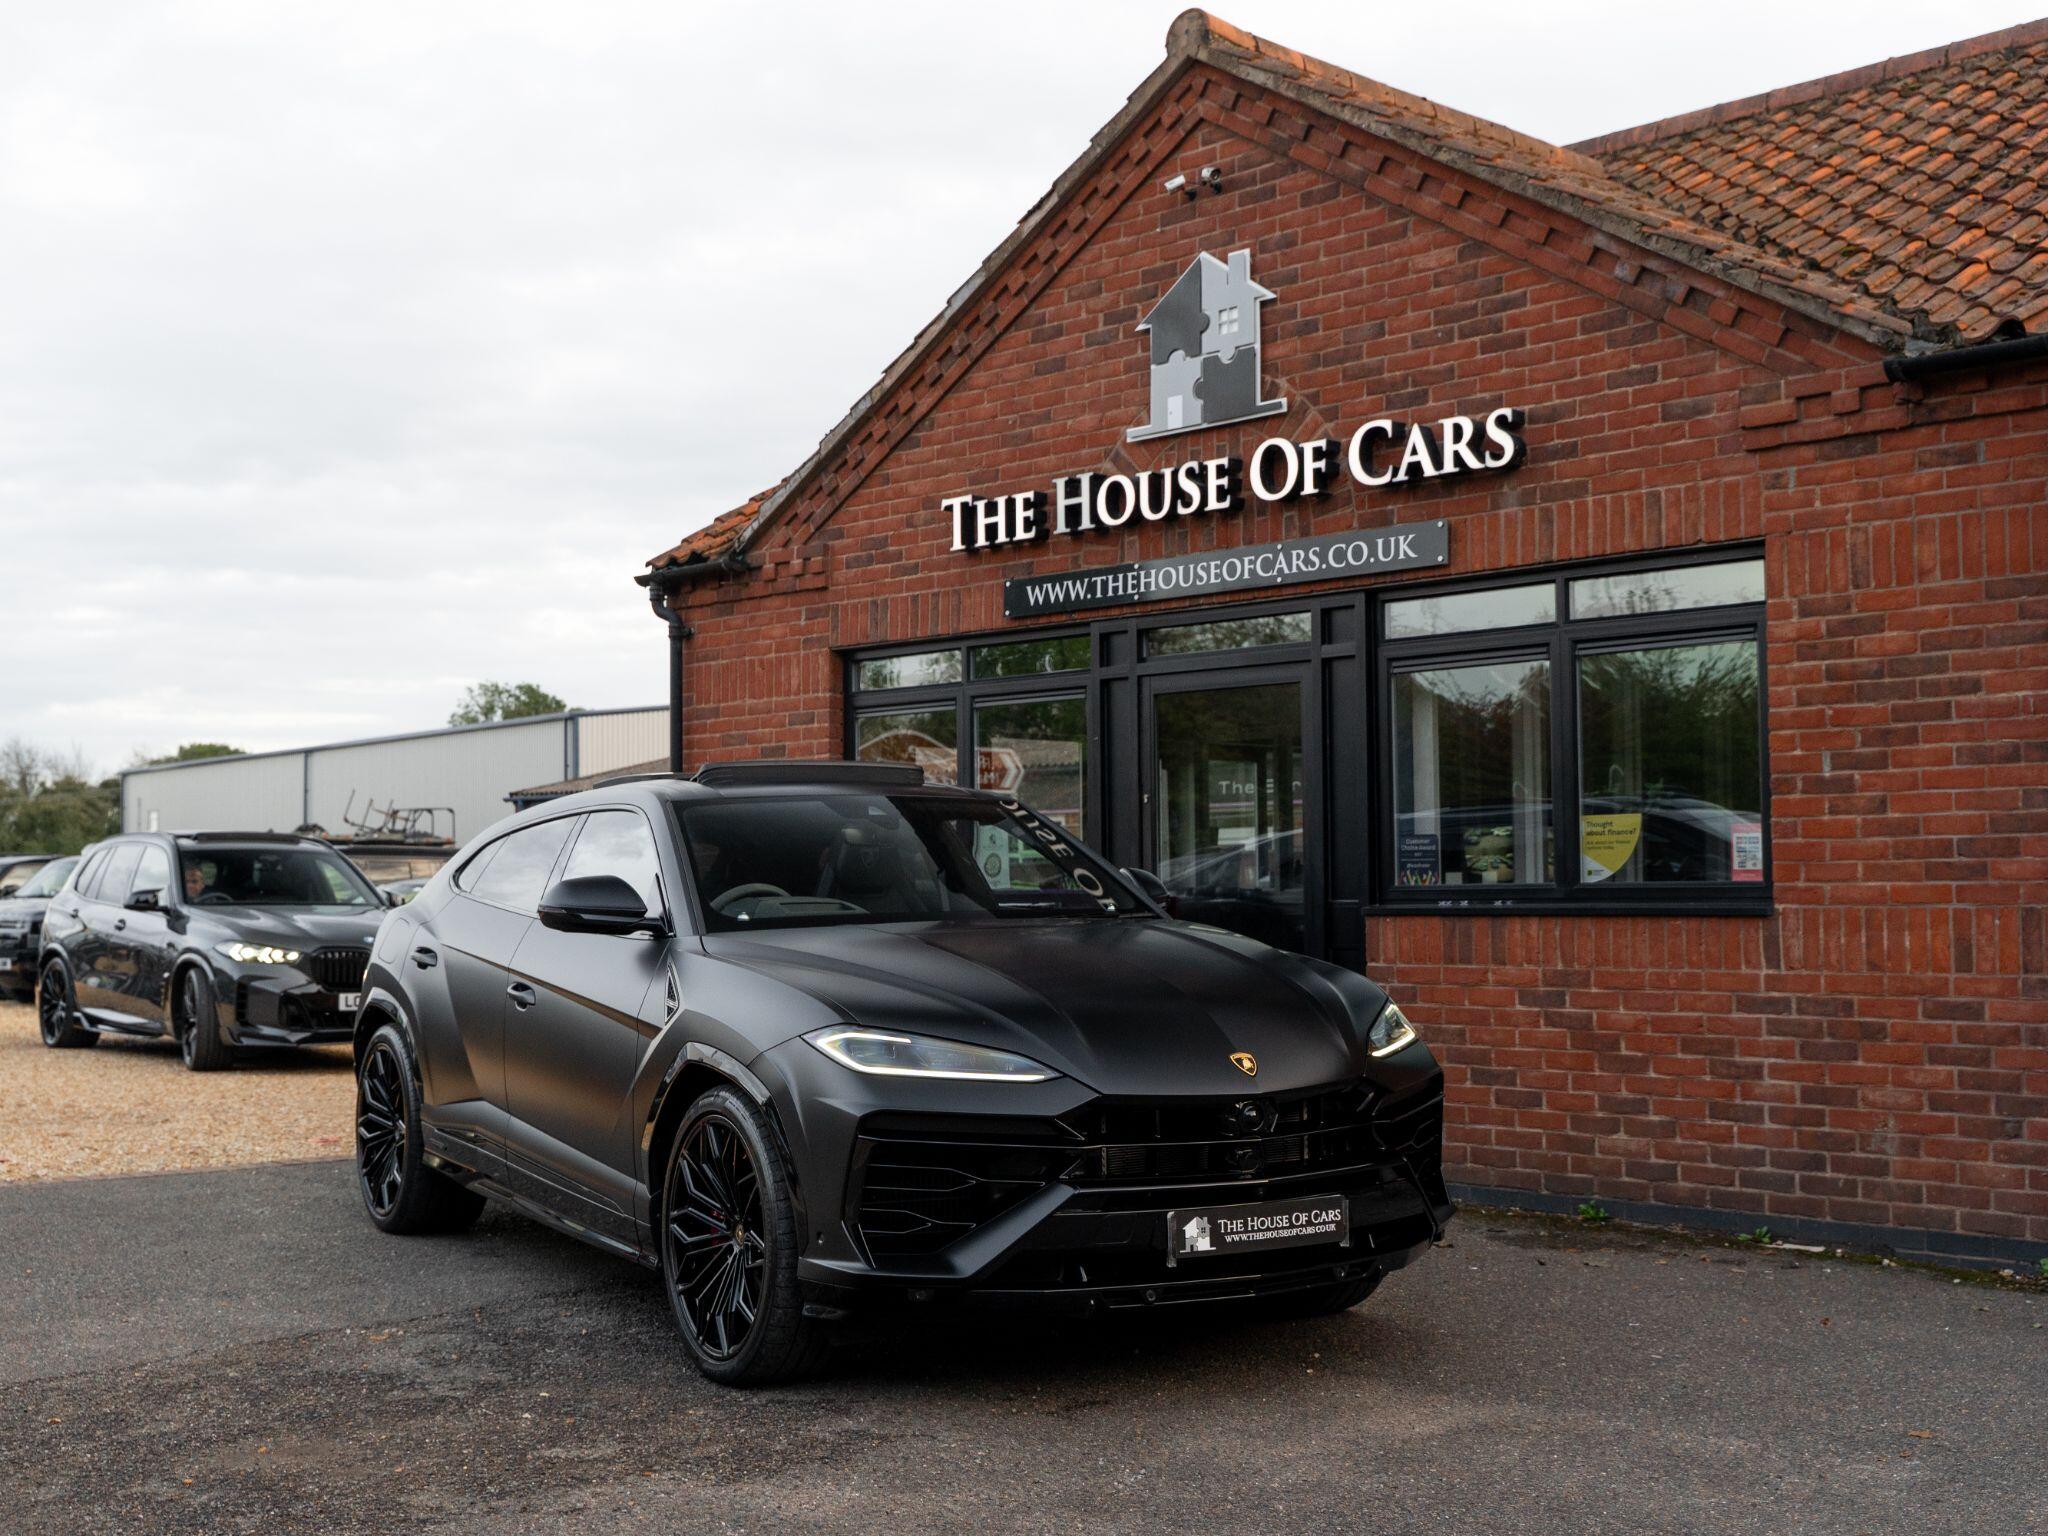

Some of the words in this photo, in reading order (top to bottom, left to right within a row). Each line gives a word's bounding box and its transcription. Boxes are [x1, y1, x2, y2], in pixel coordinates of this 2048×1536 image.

[941, 490, 1036, 551] THE
[1052, 459, 1231, 535] HOUSE
[1250, 437, 1327, 501] OF
[1348, 407, 1515, 486] CARS
[1026, 534, 1418, 607] WWW.THEHOUSEOFCARS.CO.UK
[1218, 1219, 1244, 1233] THE
[1247, 1215, 1290, 1231] HOUSE
[1292, 1212, 1309, 1225] OF
[1311, 1209, 1341, 1224] CARS
